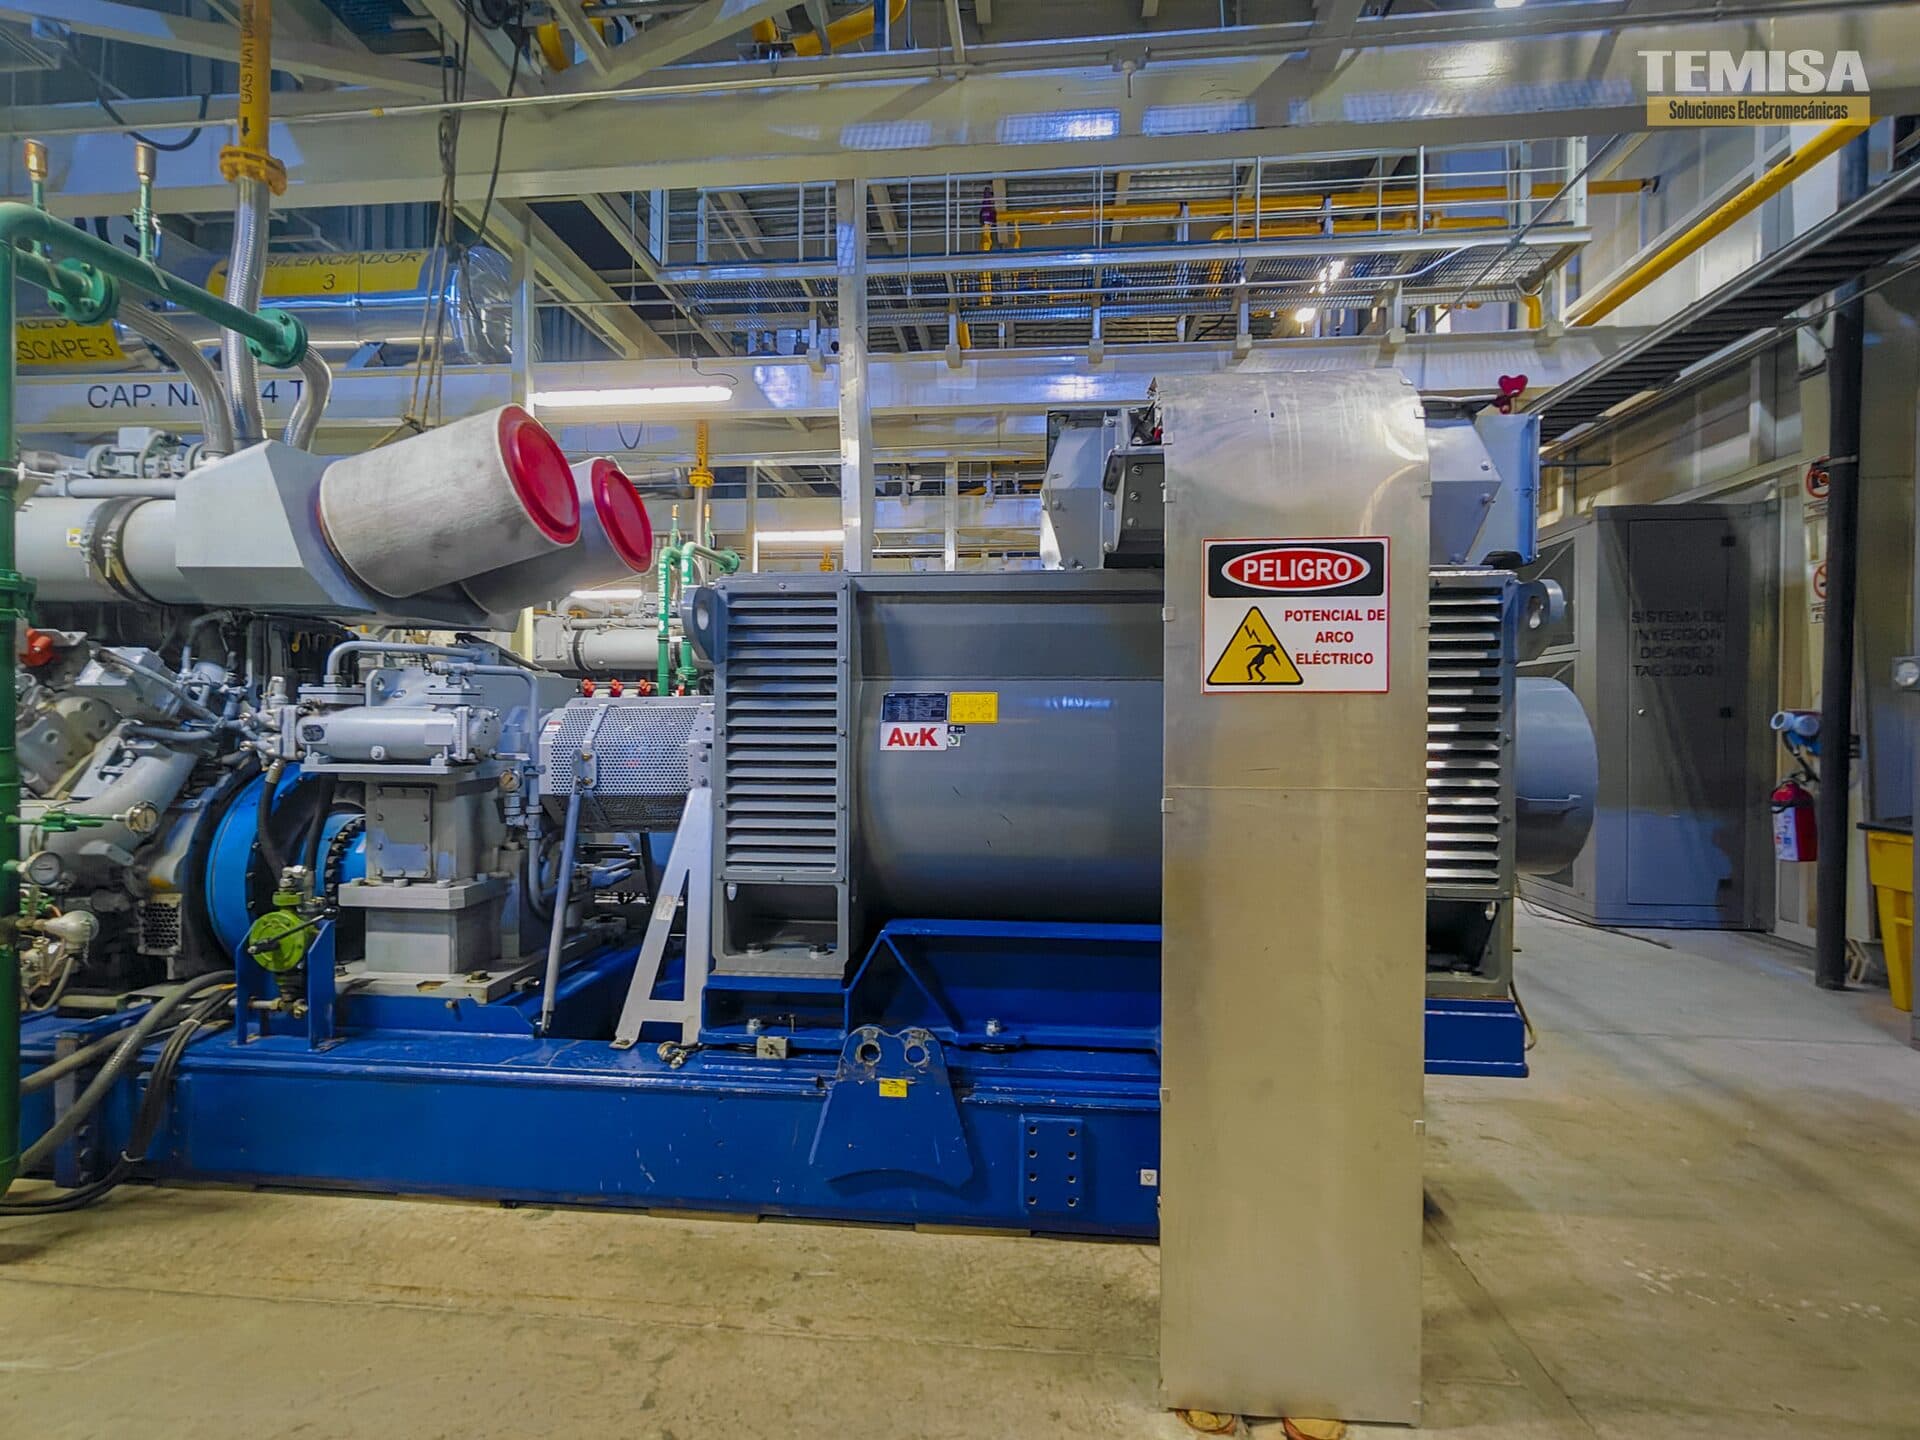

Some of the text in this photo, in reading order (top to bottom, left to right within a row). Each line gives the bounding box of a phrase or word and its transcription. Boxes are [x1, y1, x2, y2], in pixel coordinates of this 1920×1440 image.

[241, 73, 254, 105] GAS
[322, 273, 336, 290] 3
[16, 338, 115, 360] SCAPE 3
[87, 384, 156, 408] CAP.
[261, 380, 279, 404] 4
[1243, 558, 1352, 582] PELIGRO
[1284, 609, 1386, 622] POTENCIAL DE
[1315, 631, 1354, 643] ARCO
[1296, 650, 1374, 665] ELÉCTRICO
[887, 727, 939, 747] AvK
